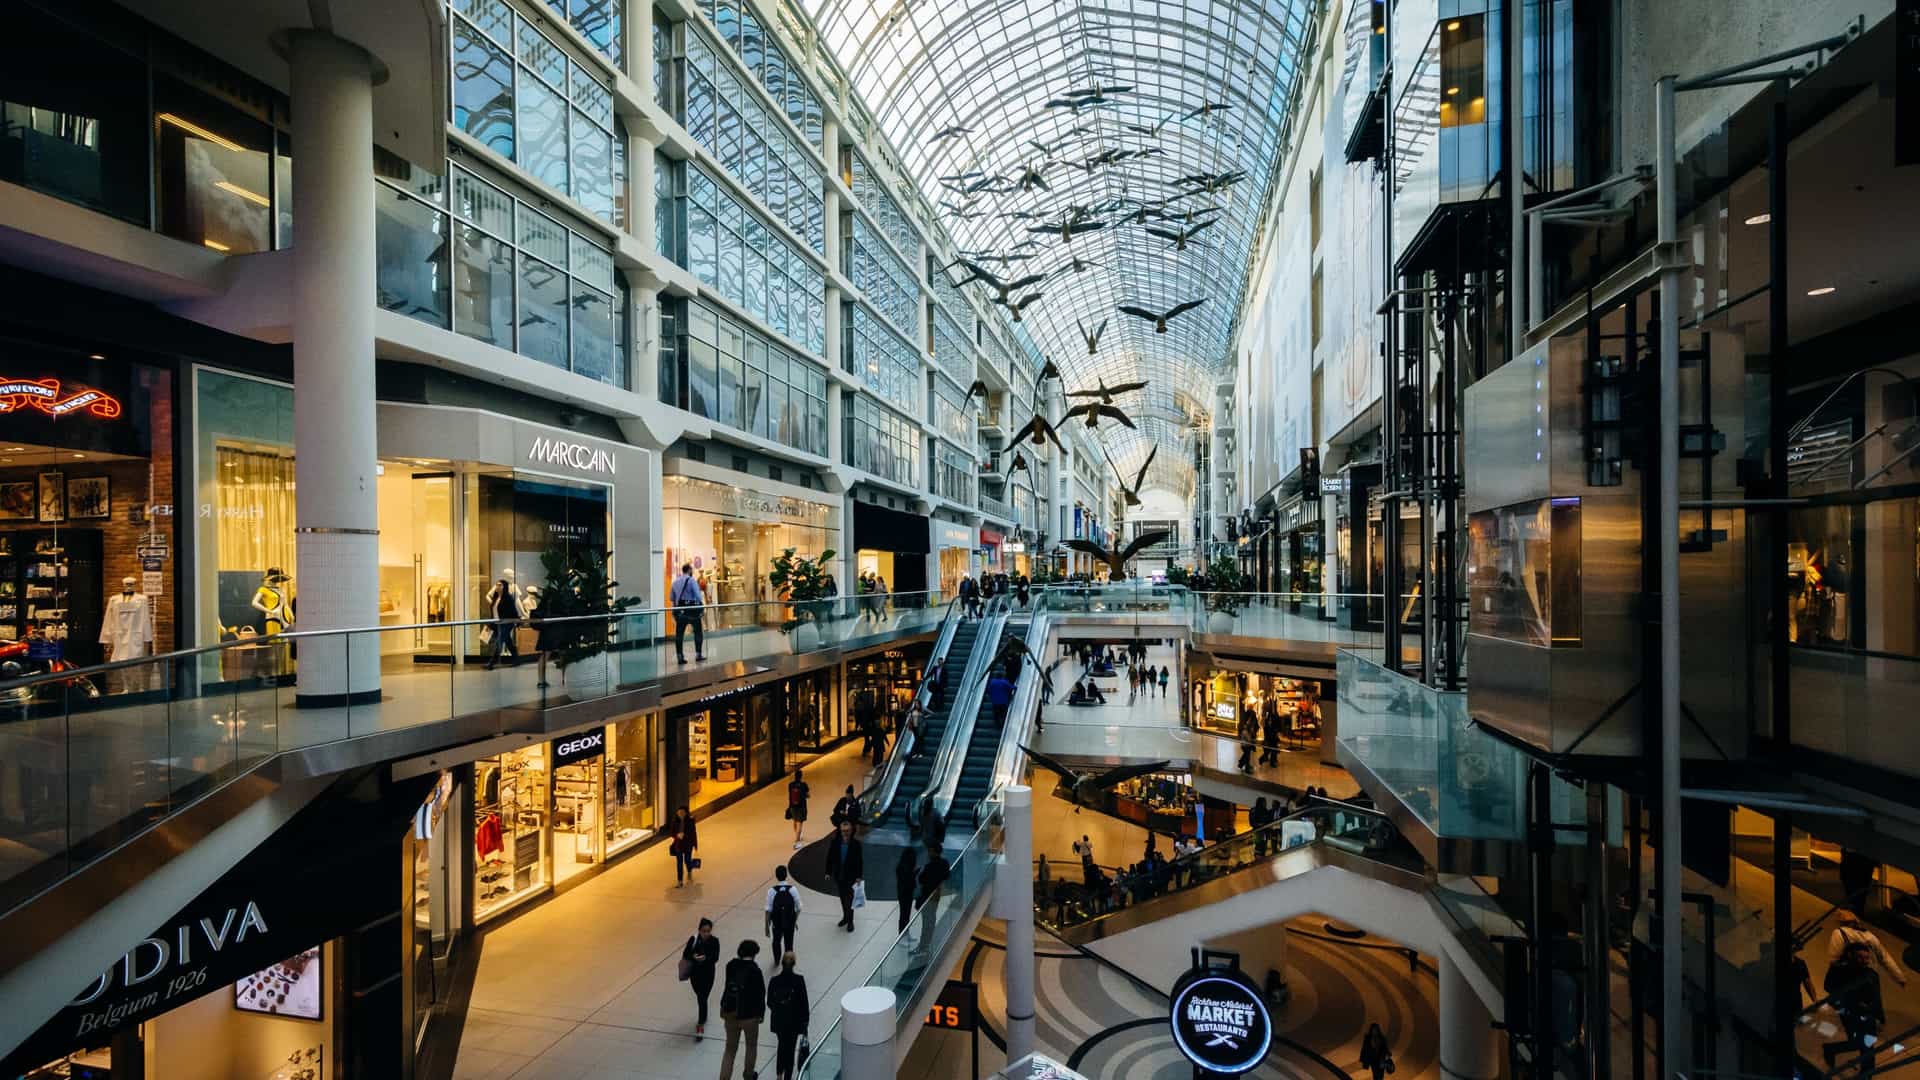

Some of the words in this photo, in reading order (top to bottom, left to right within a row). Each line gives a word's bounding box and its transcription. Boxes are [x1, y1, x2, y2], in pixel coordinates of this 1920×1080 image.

[557, 733, 602, 756] GEOX
[76, 991, 158, 1037] Belgium
[163, 966, 208, 1000] 1926
[1187, 1004, 1255, 1026] MARKET
[1194, 1023, 1248, 1038] RESTAURANTS
